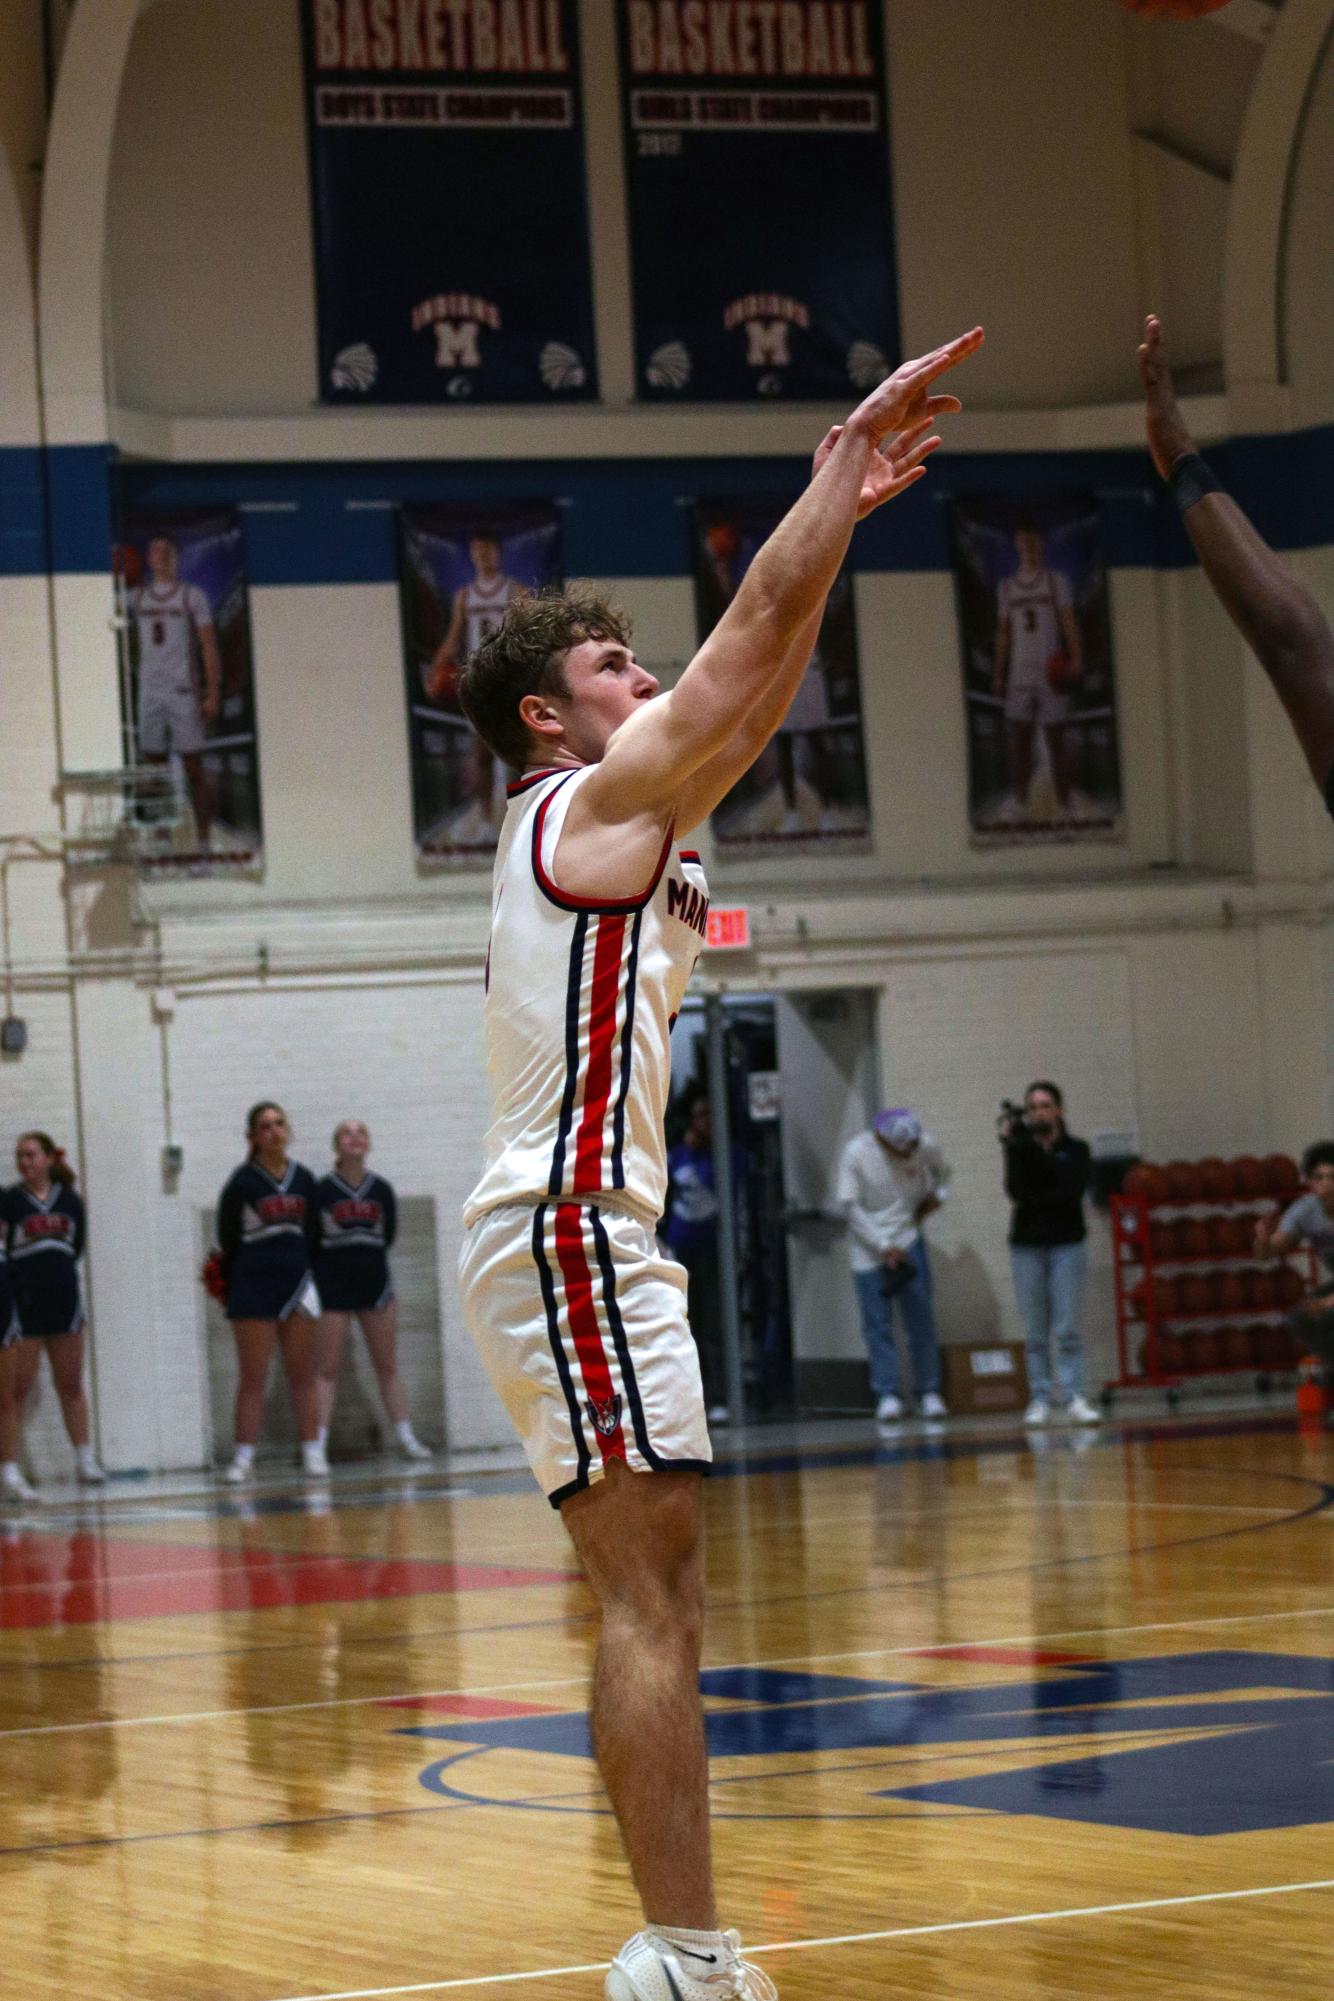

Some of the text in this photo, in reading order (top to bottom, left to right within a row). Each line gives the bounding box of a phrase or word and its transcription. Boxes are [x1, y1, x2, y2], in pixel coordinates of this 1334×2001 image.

[314, 0, 570, 71] BASKETBALL
[628, 0, 876, 75] BASKETBALL
[434, 321, 481, 368] M
[745, 321, 791, 367] M
